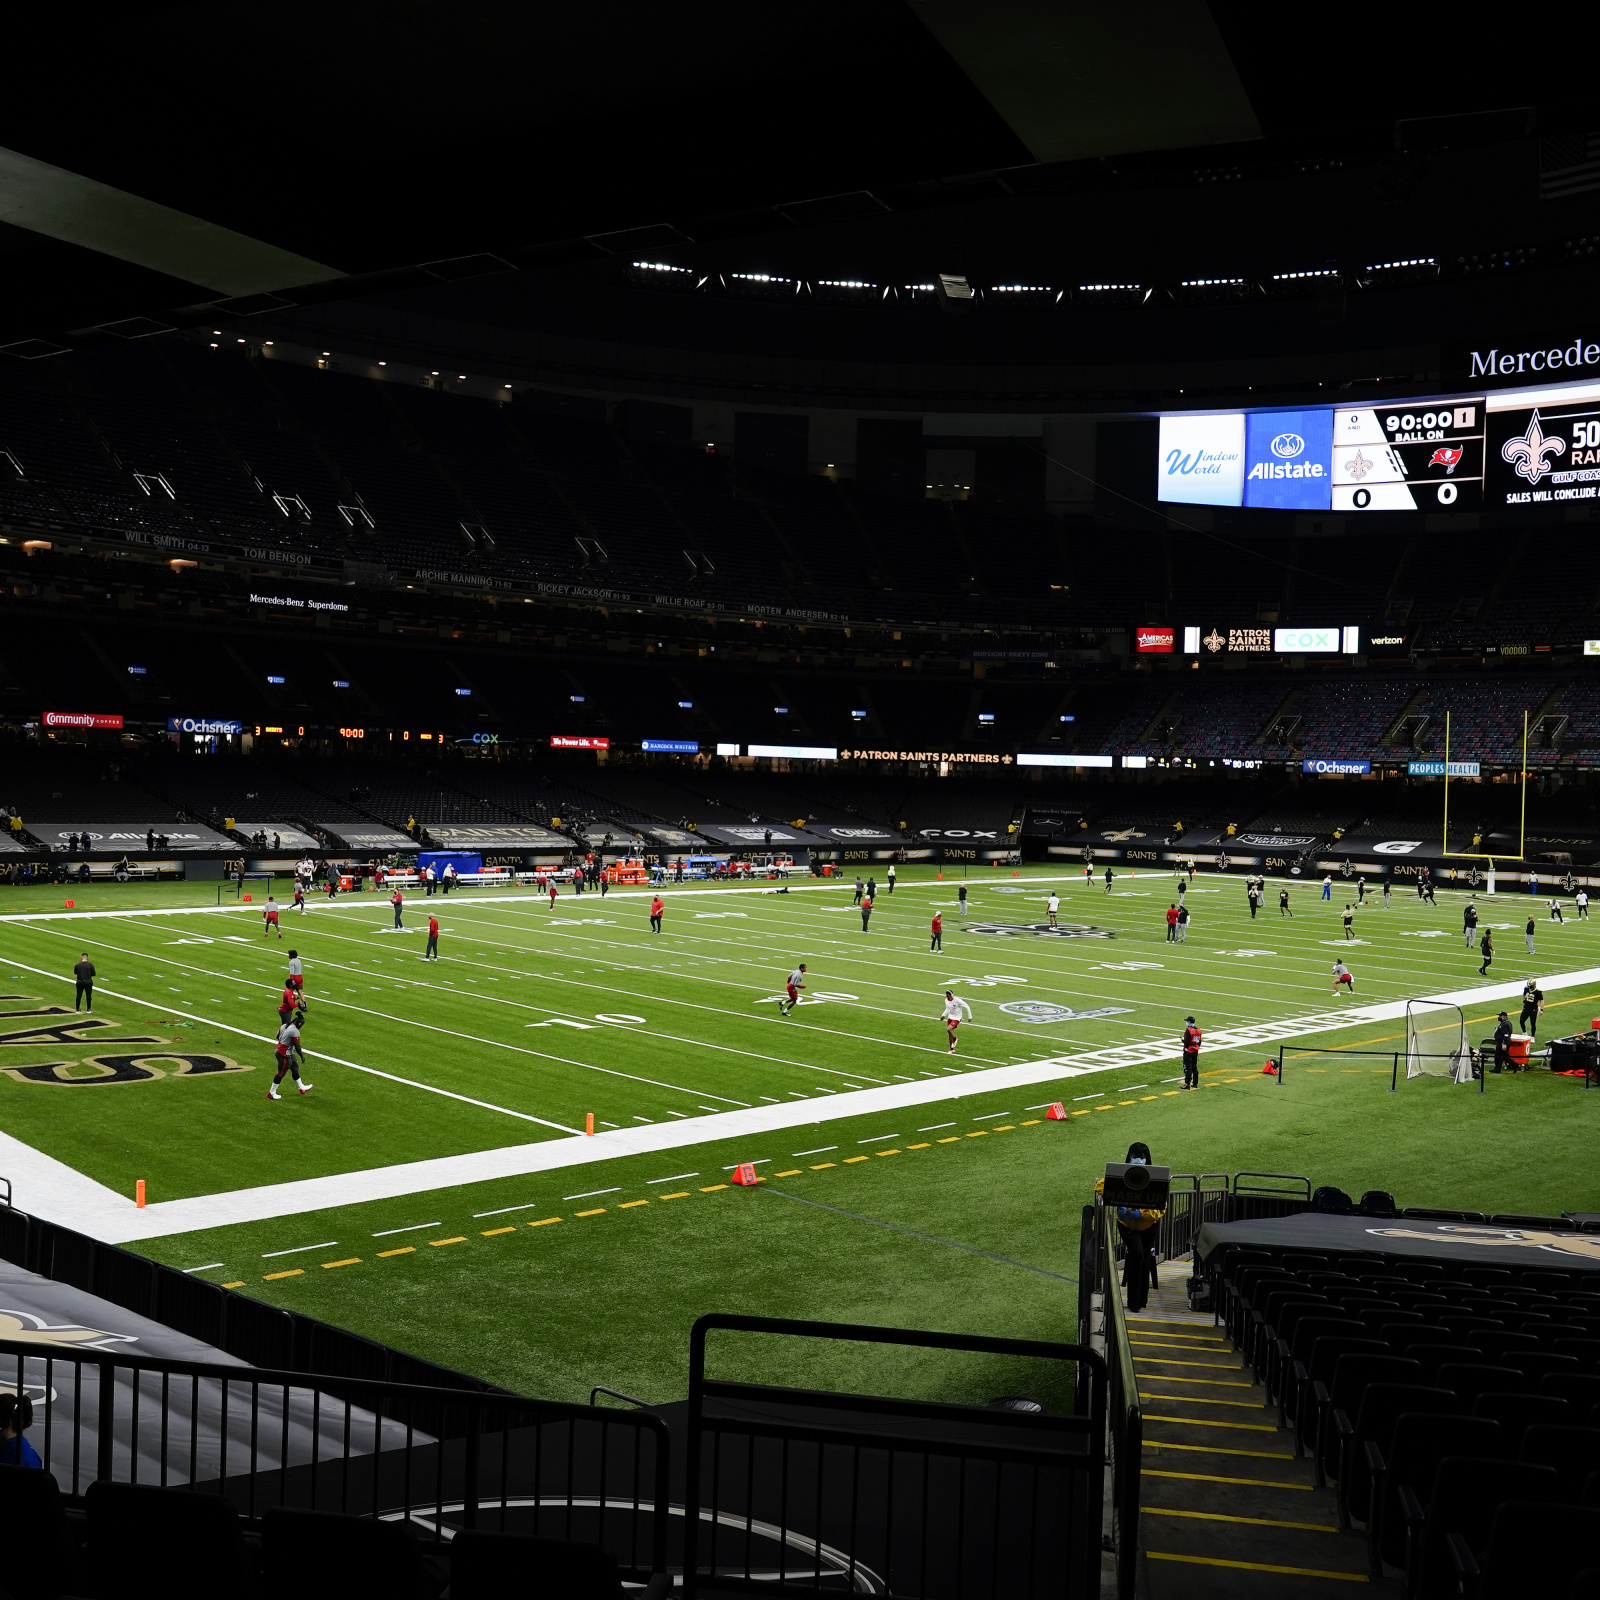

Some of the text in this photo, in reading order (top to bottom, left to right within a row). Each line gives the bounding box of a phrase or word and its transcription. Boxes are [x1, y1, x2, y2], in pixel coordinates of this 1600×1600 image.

[1351, 415, 1358, 423] 0
[1386, 411, 1453, 432] 90:00
[1461, 411, 1467, 424] 1
[1395, 430, 1445, 442] BALL ON
[1166, 449, 1239, 475] Window
[1552, 473, 1577, 483] GULF
[1352, 488, 1372, 509] 0
[1437, 482, 1458, 505] 0
[1506, 487, 1597, 504] SALES WILL CONCLUDE
[125, 530, 150, 544] WILL
[153, 535, 185, 549] SMITH
[243, 548, 312, 565] TOM BENSON
[415, 569, 449, 582] ARCHIE
[450, 573, 493, 587] MANNING
[537, 583, 570, 595] RICKEY
[572, 586, 614, 599] JACKSON
[250, 593, 349, 612] Mercedes-Benz Superdome
[655, 595, 683, 606] WILLIE
[684, 598, 706, 608] ROAF
[747, 605, 782, 615] MORTEN
[786, 608, 829, 619] ANDERSEN
[1229, 629, 1271, 637] PATRON
[1229, 636, 1271, 645] SAINTS
[1284, 633, 1329, 648] COX
[1371, 636, 1403, 645] verizon
[1500, 646, 1528, 655] VOODOO
[46, 712, 96, 727] Community
[182, 718, 237, 735] Ochsner
[299, 726, 305, 736] 0
[340, 728, 365, 738] 90:00
[404, 731, 409, 740] 0
[473, 733, 499, 744] COX
[562, 738, 579, 746] Power
[853, 750, 1000, 764] PATRON SAINTS PARTNERS
[1316, 761, 1365, 774] Ochsner
[1409, 763, 1479, 775] PEOPLES HEALTH
[355, 834, 407, 842] HONOR
[426, 827, 548, 837] SAINTS
[919, 829, 998, 839] COX
[844, 850, 869, 860] SAINTS
[944, 849, 976, 859] SAINTS
[1126, 850, 1157, 861] SAINTS
[485, 856, 522, 867] SAINTS
[1394, 866, 1424, 875] SAINT
[543, 1012, 647, 1030] 10
[743, 1165, 755, 1182] G
[1105, 1190, 1164, 1202] MASK UP
